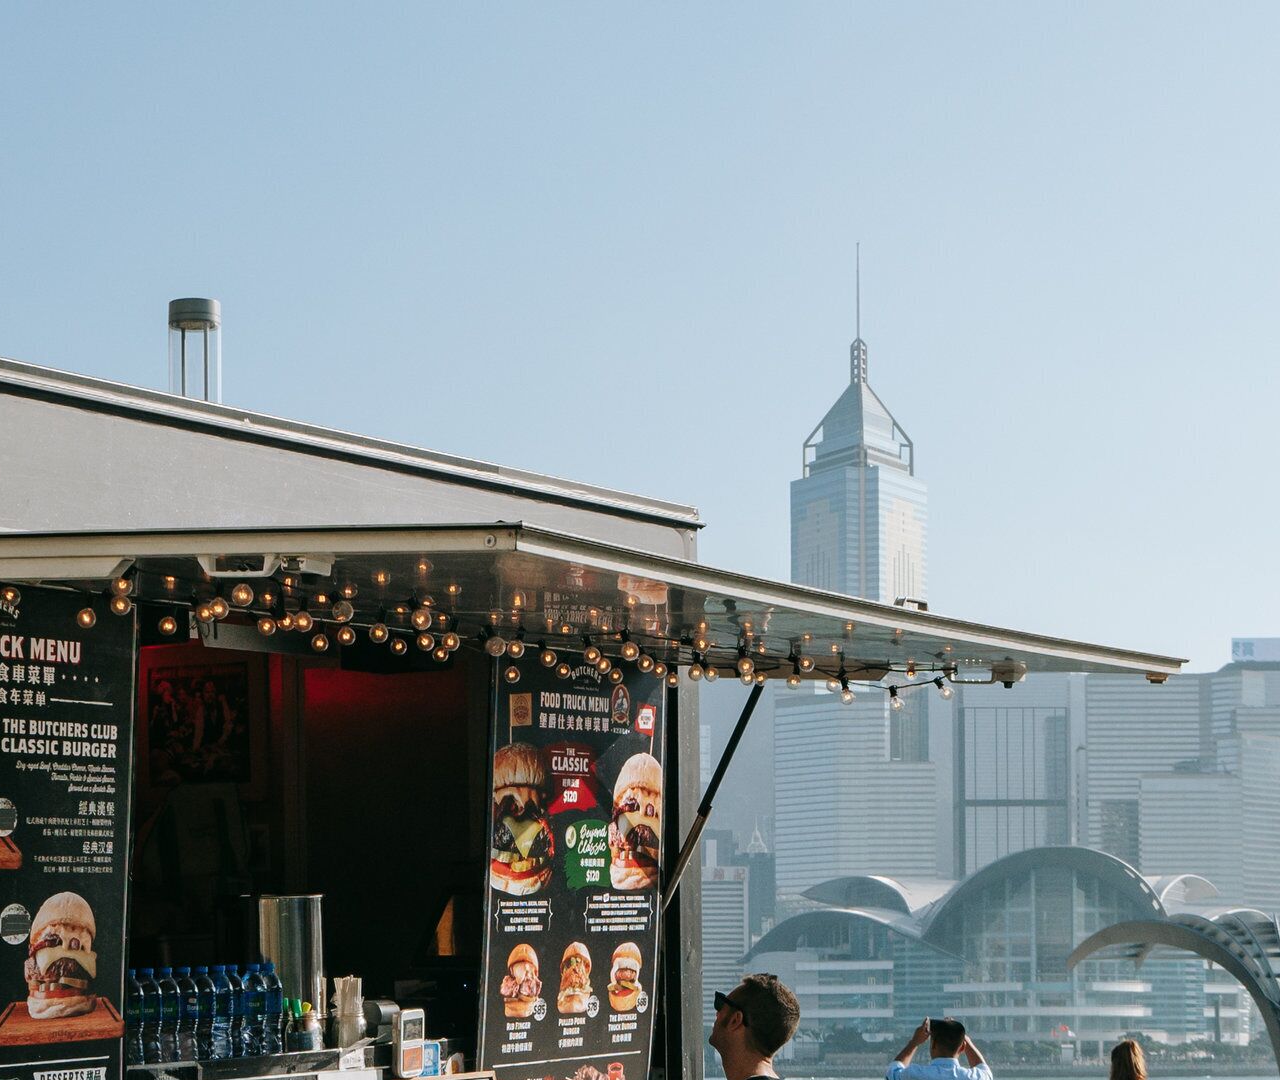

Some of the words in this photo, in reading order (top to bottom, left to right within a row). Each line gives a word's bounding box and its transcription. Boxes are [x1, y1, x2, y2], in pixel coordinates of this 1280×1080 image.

[30, 637, 82, 664] MENU
[571, 666, 602, 684] BUTCHERS
[540, 692, 560, 708] FOOD
[562, 694, 586, 711] TRUCK
[588, 697, 610, 713] MENU
[2, 718, 27, 734] THE
[29, 719, 88, 738] BUTCHERS
[91, 724, 118, 740] CLUB
[539, 712, 609, 733] 堡爵仕美食車菜單
[1, 737, 59, 755] CLASSIC
[62, 741, 117, 758] BURGER
[552, 756, 589, 772] CLASSIC
[563, 789, 578, 804] $120
[580, 824, 607, 843] Beyond
[577, 839, 607, 855] Classic
[534, 1004, 545, 1015] $85
[587, 1002, 598, 1012] $78
[574, 1017, 586, 1025] PORK
[621, 1022, 637, 1030] BURGER
[509, 1032, 527, 1040] BURGER
[563, 1027, 580, 1035] BURGER
